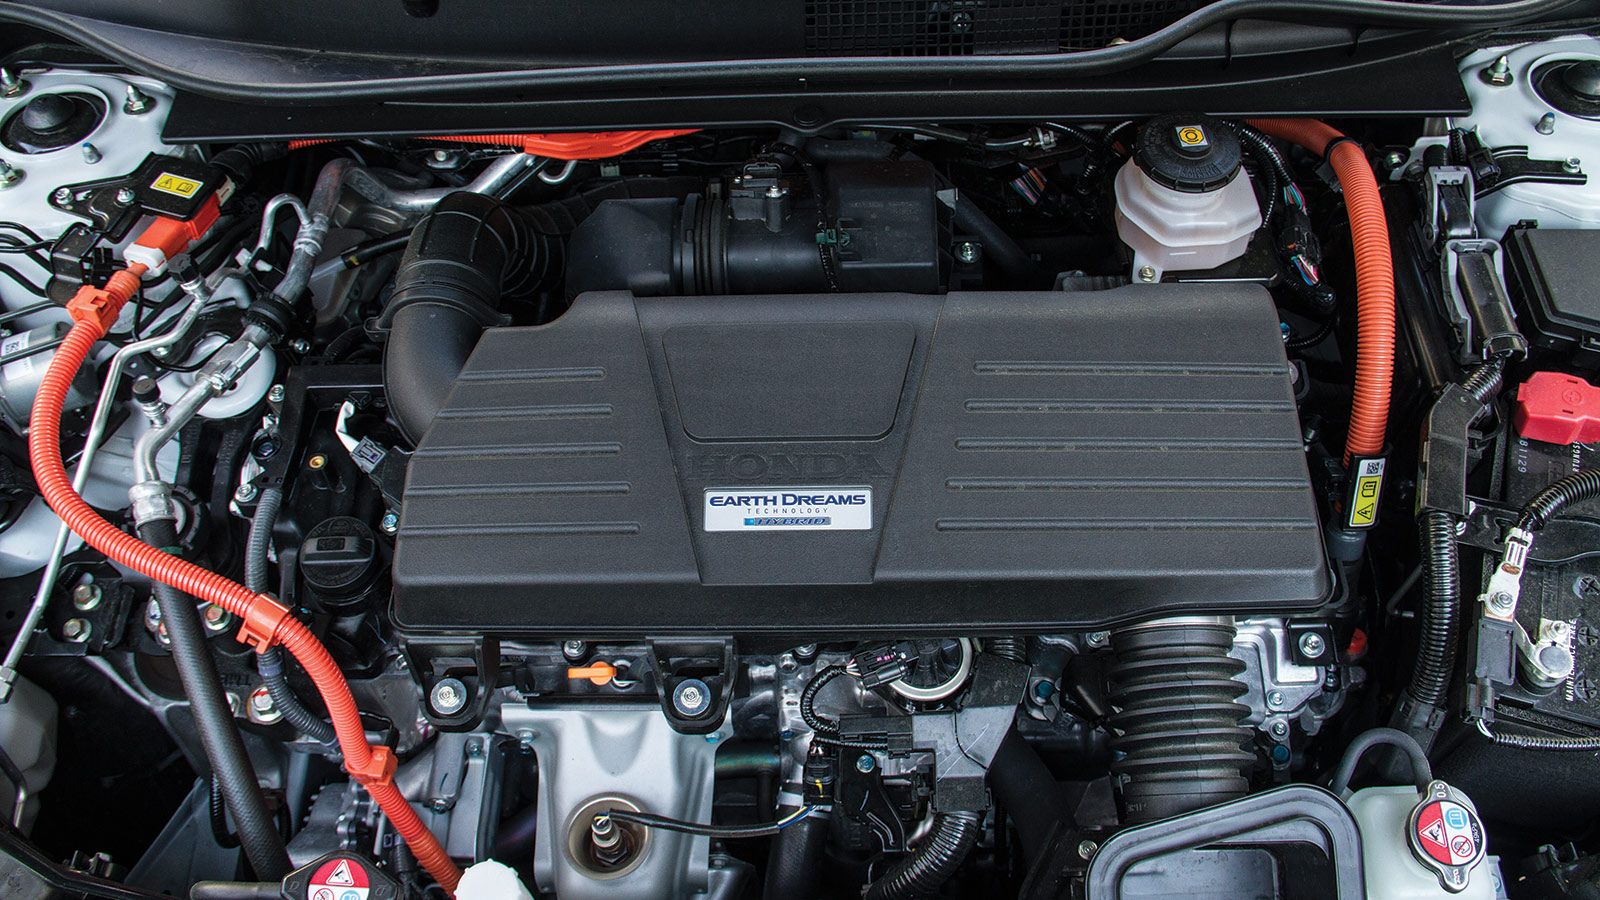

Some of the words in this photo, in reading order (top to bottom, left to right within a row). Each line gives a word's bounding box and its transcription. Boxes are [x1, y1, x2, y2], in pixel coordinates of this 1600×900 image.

[709, 495, 777, 506] EARTH
[782, 493, 866, 505] DREAMS
[1434, 783, 1447, 798] 0.5
